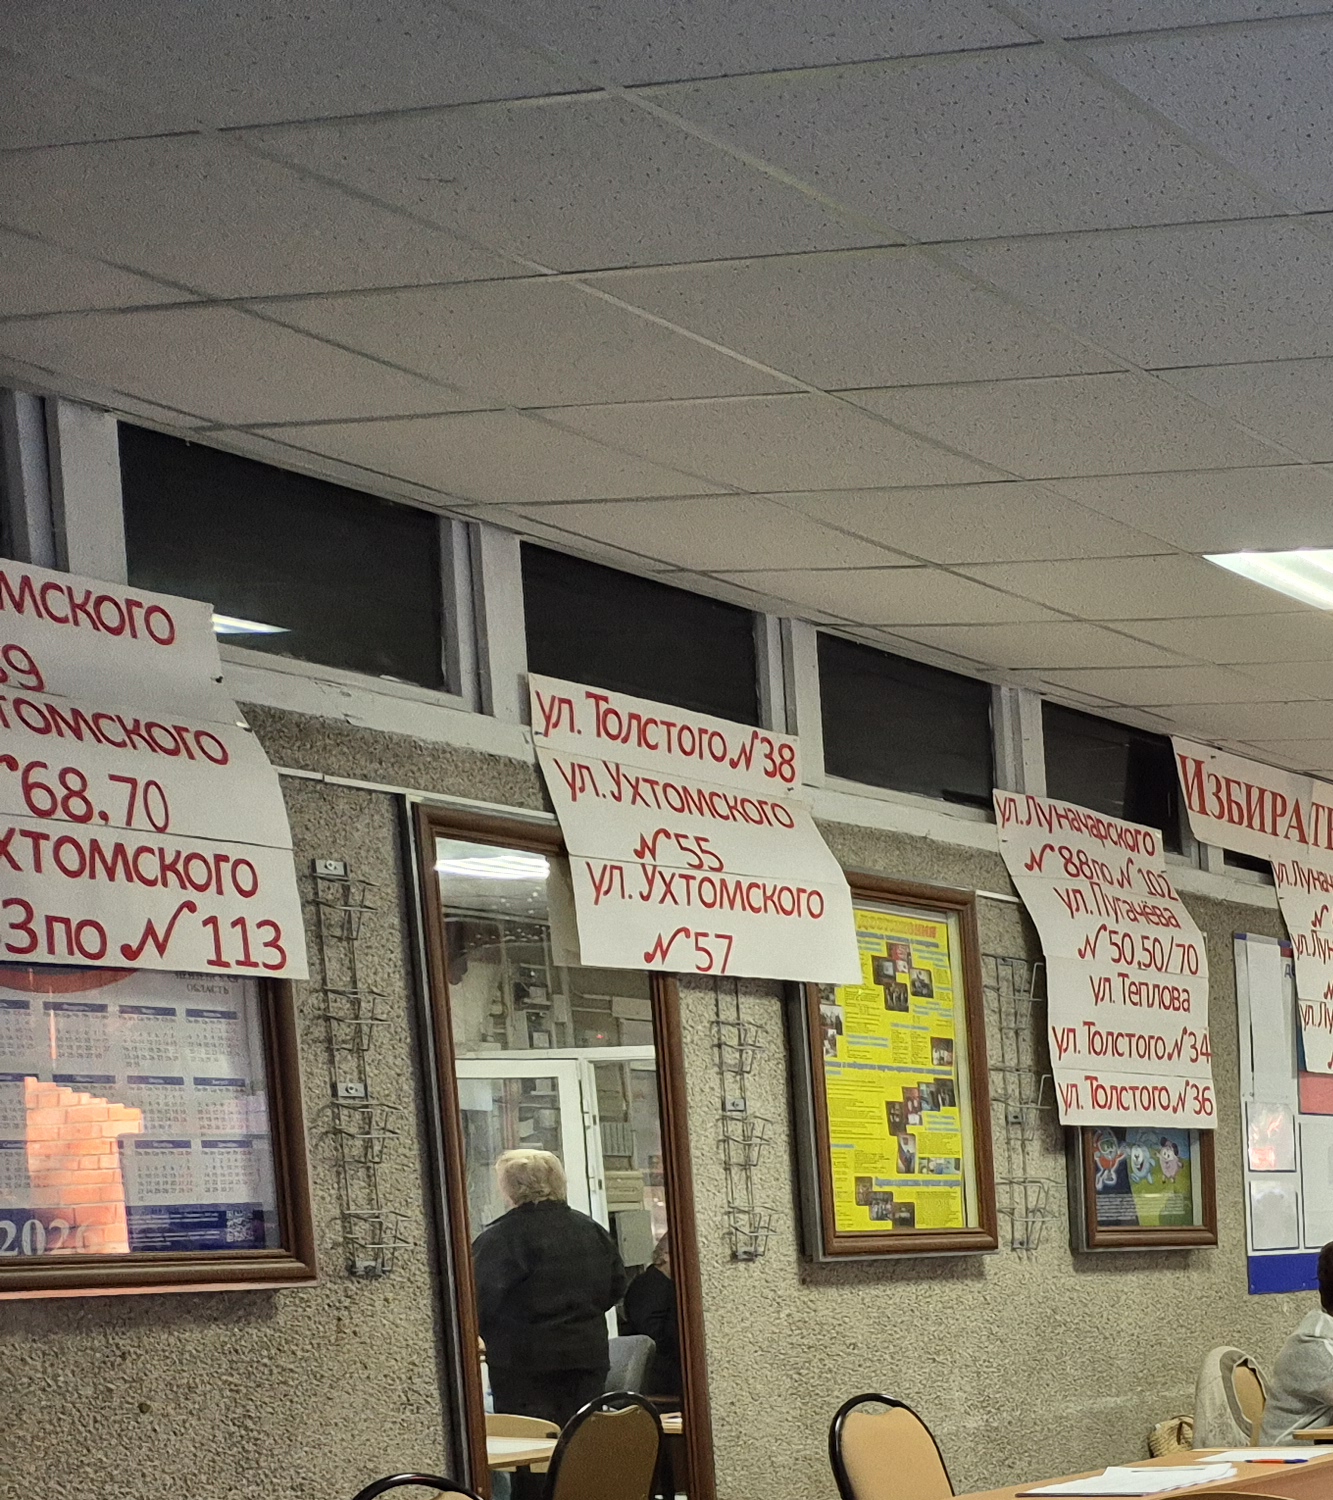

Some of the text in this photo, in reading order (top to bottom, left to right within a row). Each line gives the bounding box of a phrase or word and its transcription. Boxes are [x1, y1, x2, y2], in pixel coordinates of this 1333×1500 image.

[0, 643, 45, 693] 9
[535, 690, 583, 738] ул.
[553, 757, 607, 802] ул.
[995, 794, 1156, 857] ул. Луначарского
[585, 860, 634, 906] ул.
[1053, 881, 1182, 930] ул. Пугачёва
[1089, 971, 1191, 1014] ул. Теплова
[1052, 1025, 1081, 1062] ул.
[1058, 1081, 1084, 1116] ул.
